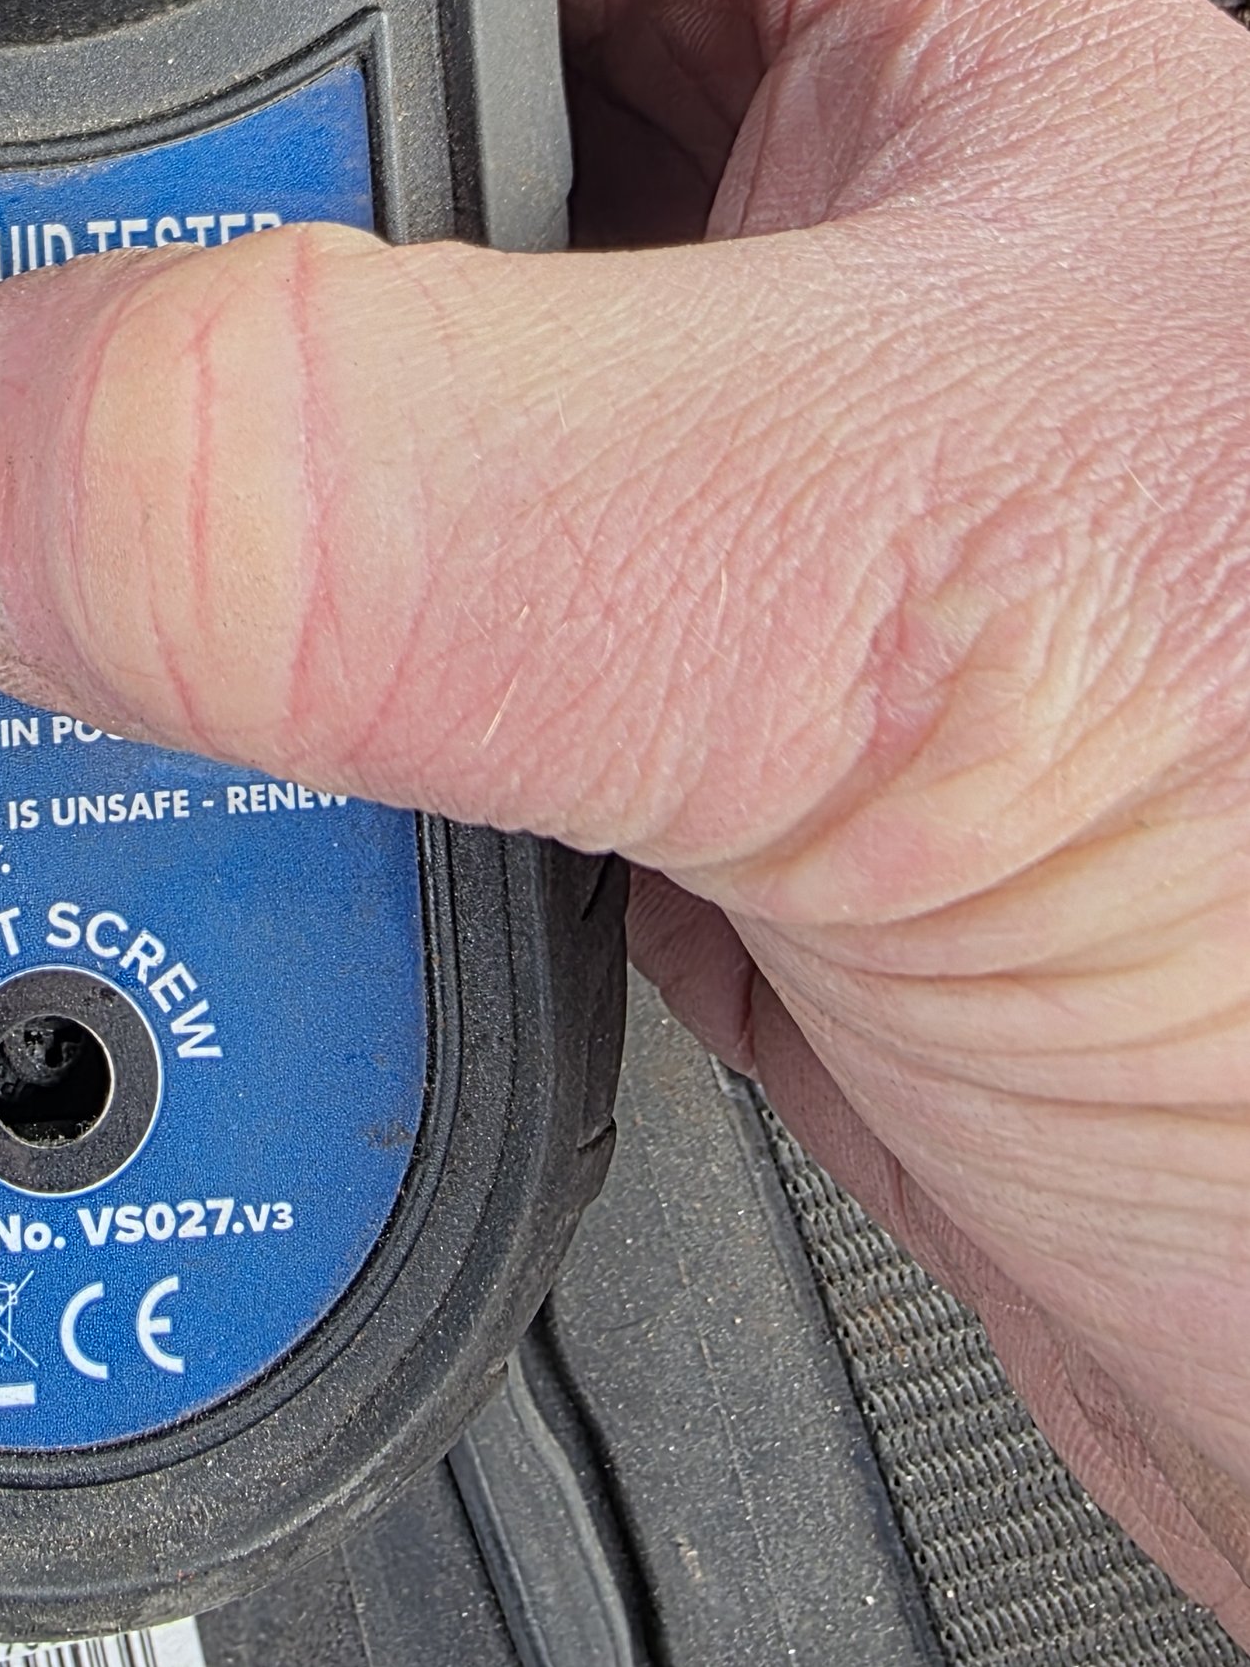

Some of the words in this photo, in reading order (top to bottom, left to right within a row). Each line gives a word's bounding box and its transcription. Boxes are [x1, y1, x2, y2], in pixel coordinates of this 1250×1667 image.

[0, 717, 40, 747] IN
[52, 715, 126, 744] PO
[8, 798, 40, 830] IS
[51, 788, 191, 826] UNSAFE
[47, 901, 223, 1060] SCREW
